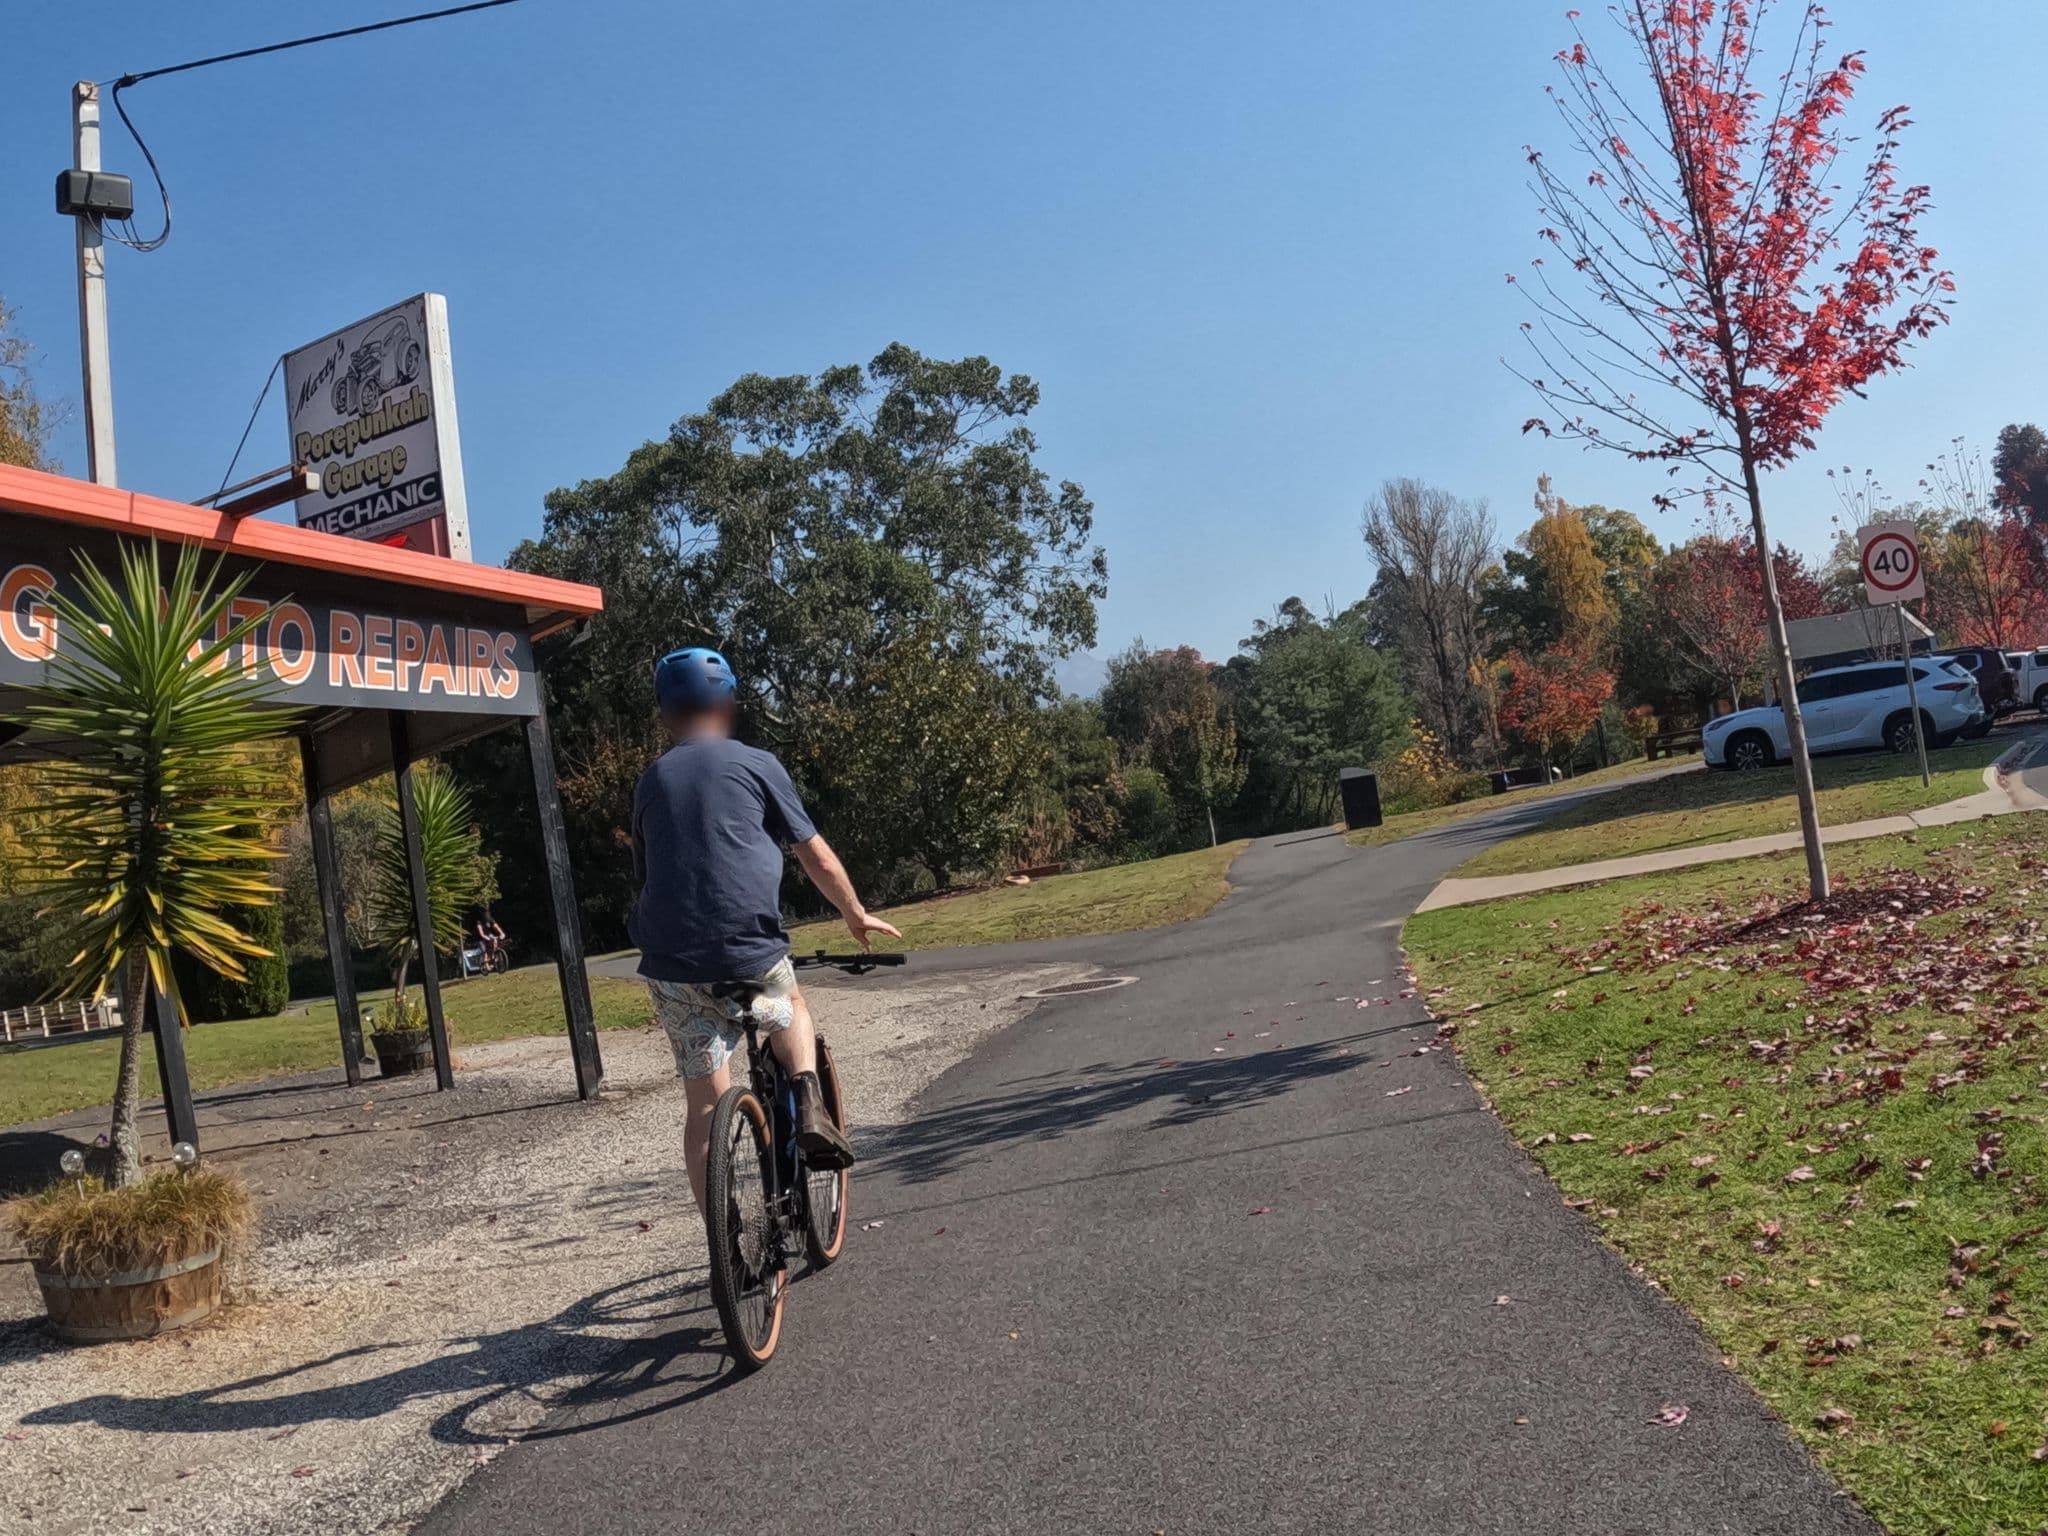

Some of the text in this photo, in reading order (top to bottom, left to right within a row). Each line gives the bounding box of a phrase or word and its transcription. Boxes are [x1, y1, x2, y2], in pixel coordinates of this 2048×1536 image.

[297, 386, 429, 462] Porepunkah
[323, 445, 407, 499] Garage
[306, 477, 437, 533] MECHANIC
[1874, 548, 1909, 574] 40
[157, 586, 316, 685] UTO
[328, 609, 519, 700] REPAIRS
